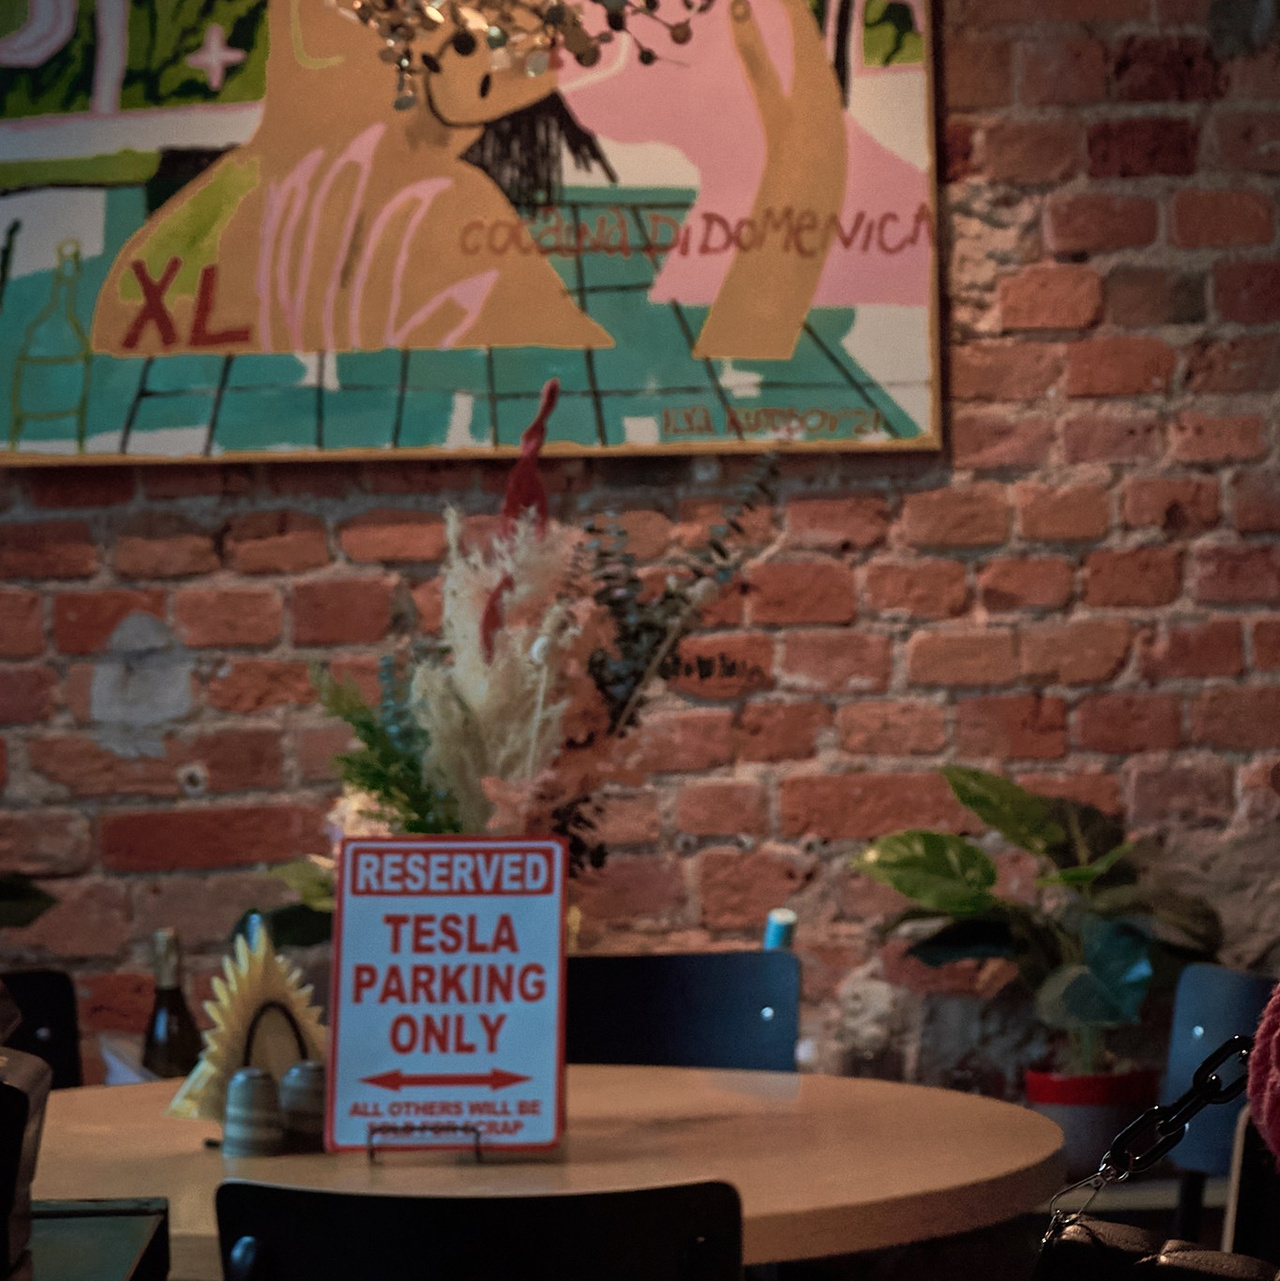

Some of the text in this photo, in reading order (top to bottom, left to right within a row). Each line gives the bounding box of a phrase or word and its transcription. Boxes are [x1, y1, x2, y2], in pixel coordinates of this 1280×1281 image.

[122, 256, 252, 349] XL
[357, 853, 549, 892] RESERVED
[383, 913, 519, 954] TESLA
[352, 963, 547, 1004] PARKING
[389, 1013, 507, 1054] ONLY
[350, 1100, 542, 1117] ALL OTHERS WILL BE
